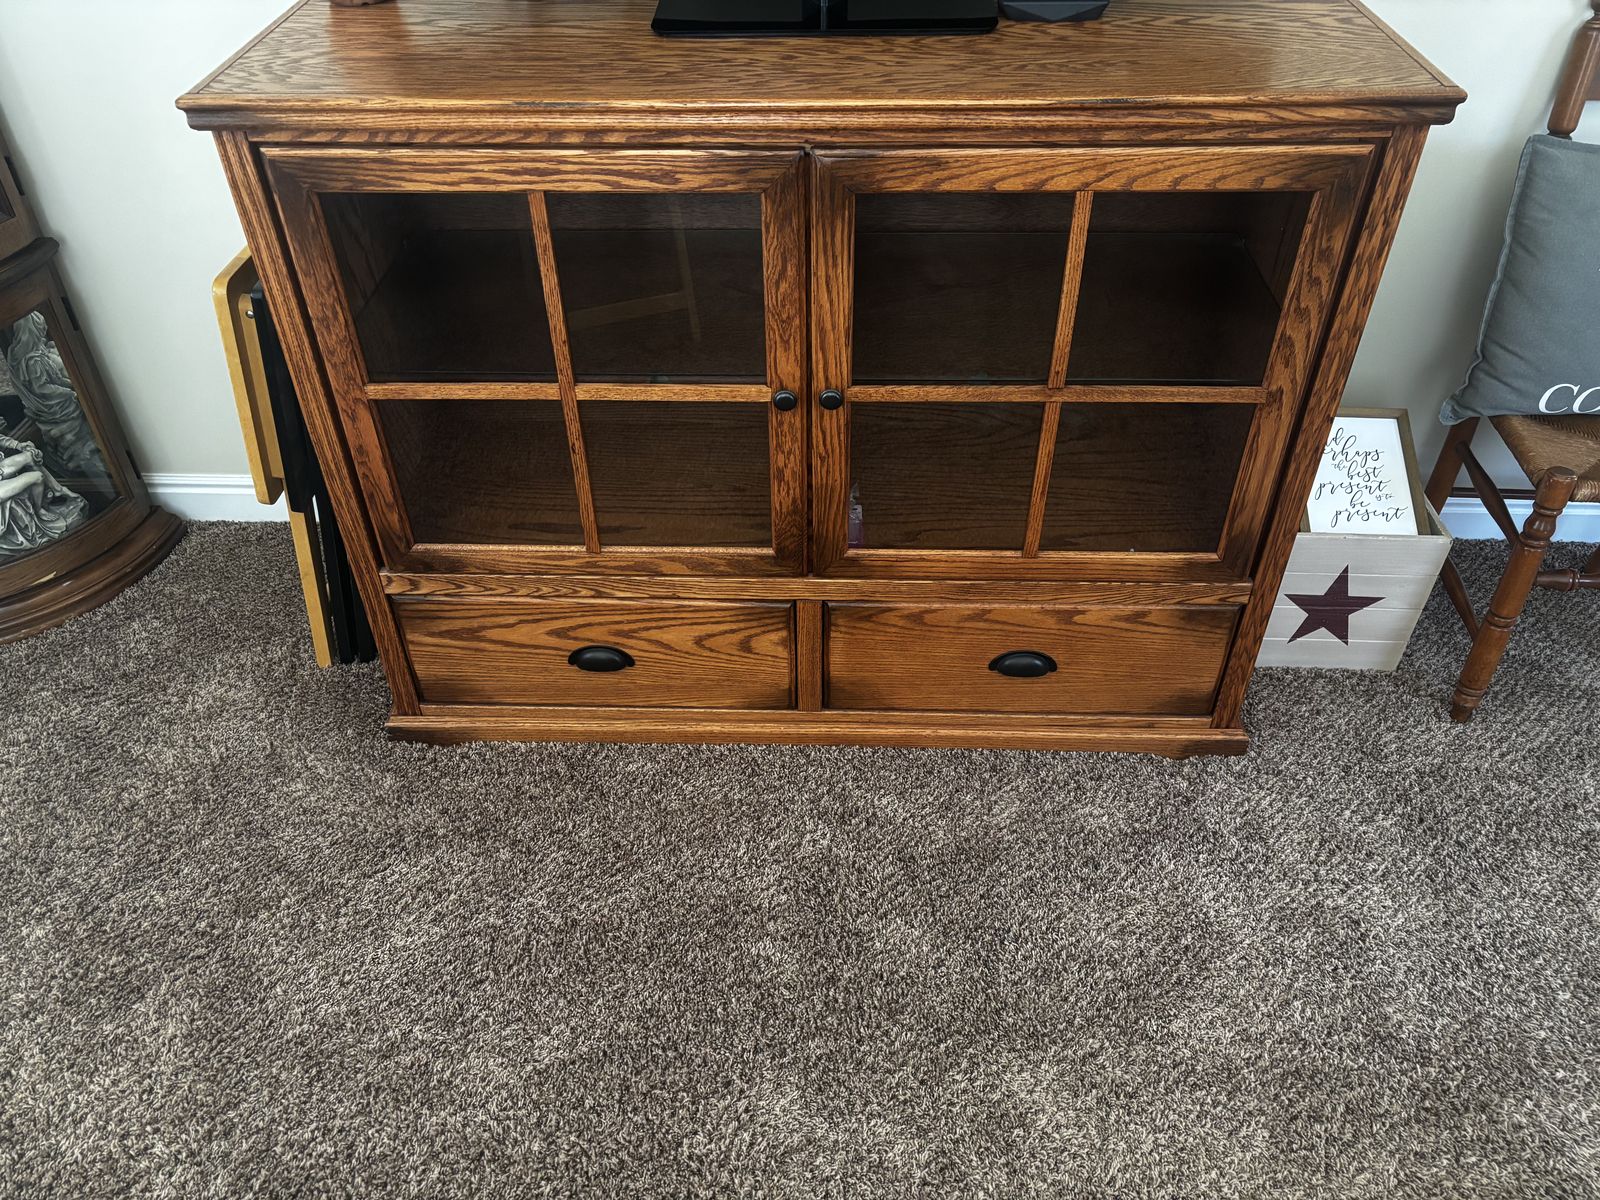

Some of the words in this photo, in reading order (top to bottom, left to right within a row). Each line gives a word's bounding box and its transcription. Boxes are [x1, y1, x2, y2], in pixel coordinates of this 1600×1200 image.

[1347, 460, 1385, 482] best
[1315, 480, 1391, 500] present
[1350, 490, 1371, 508] be
[1331, 506, 1408, 528] present
